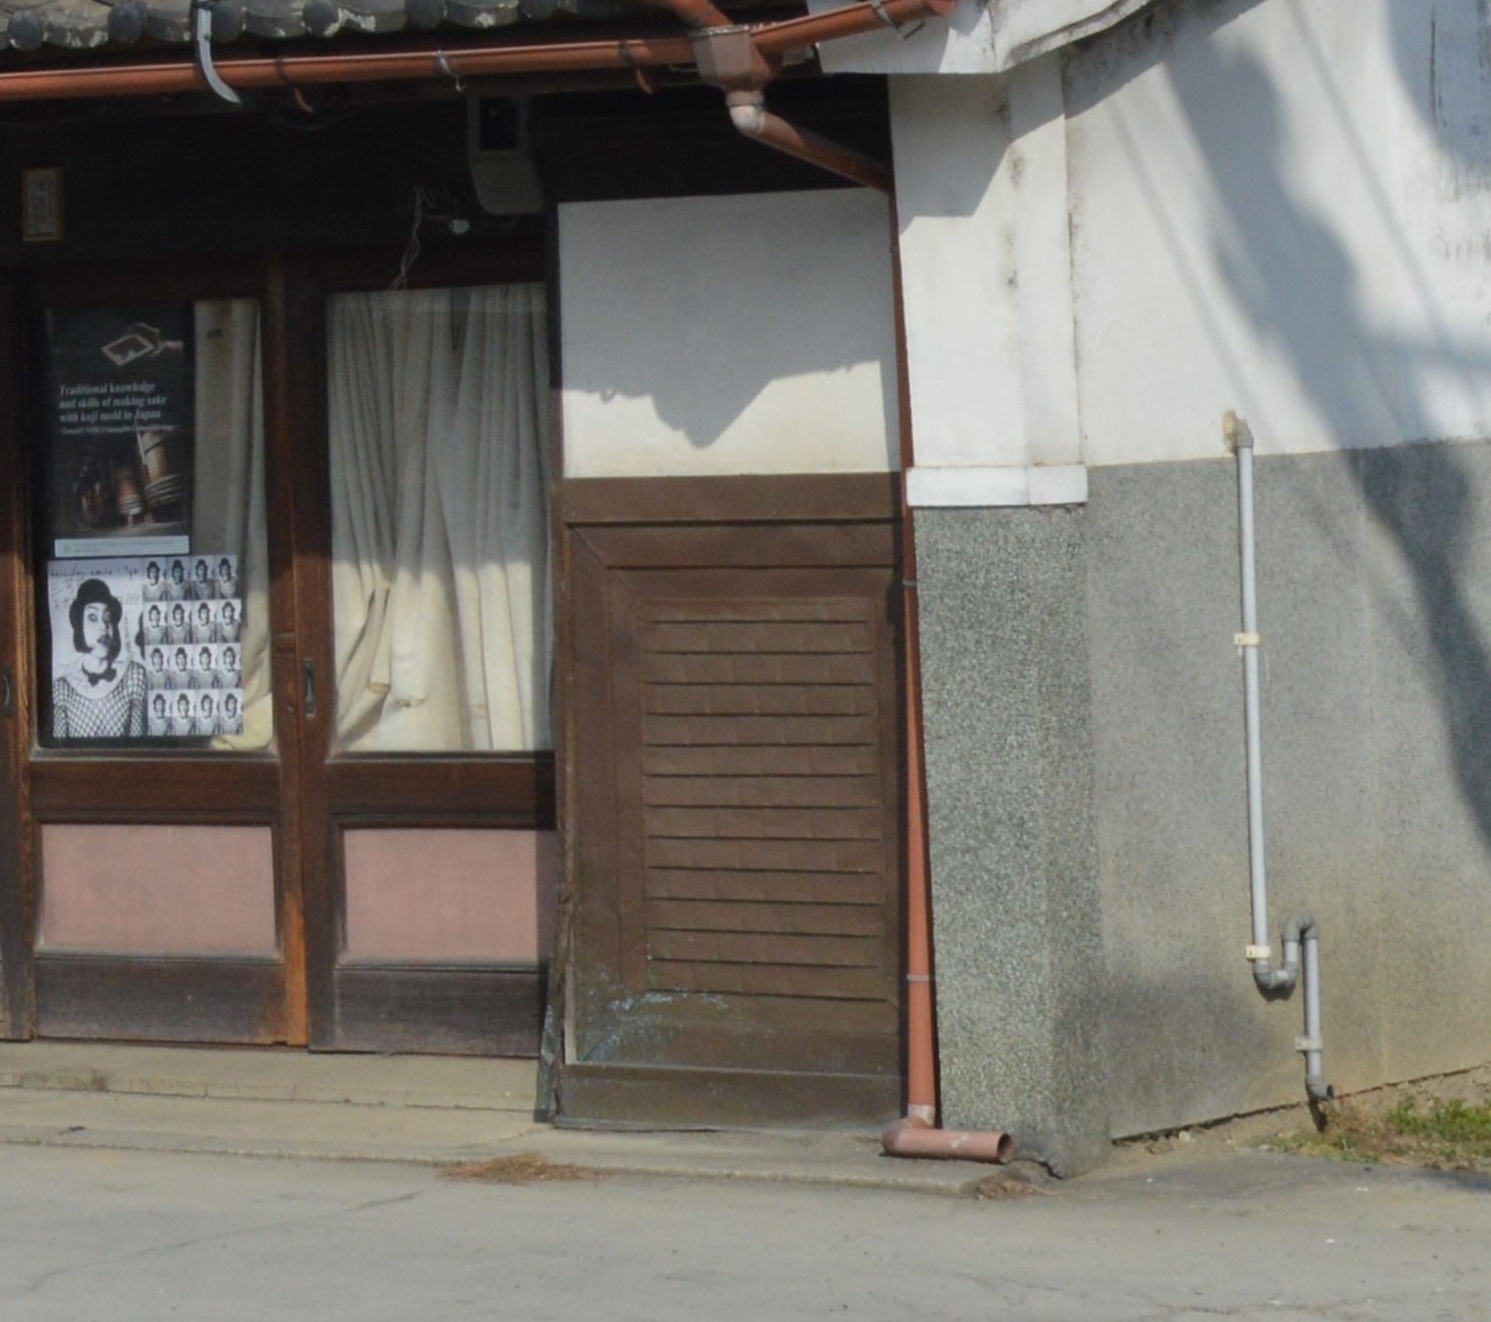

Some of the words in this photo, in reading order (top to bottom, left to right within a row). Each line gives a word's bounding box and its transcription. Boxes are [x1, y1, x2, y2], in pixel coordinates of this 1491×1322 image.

[60, 383, 108, 395] Traditional
[109, 381, 155, 394] knowledge
[60, 411, 78, 422] with
[123, 409, 132, 420] in
